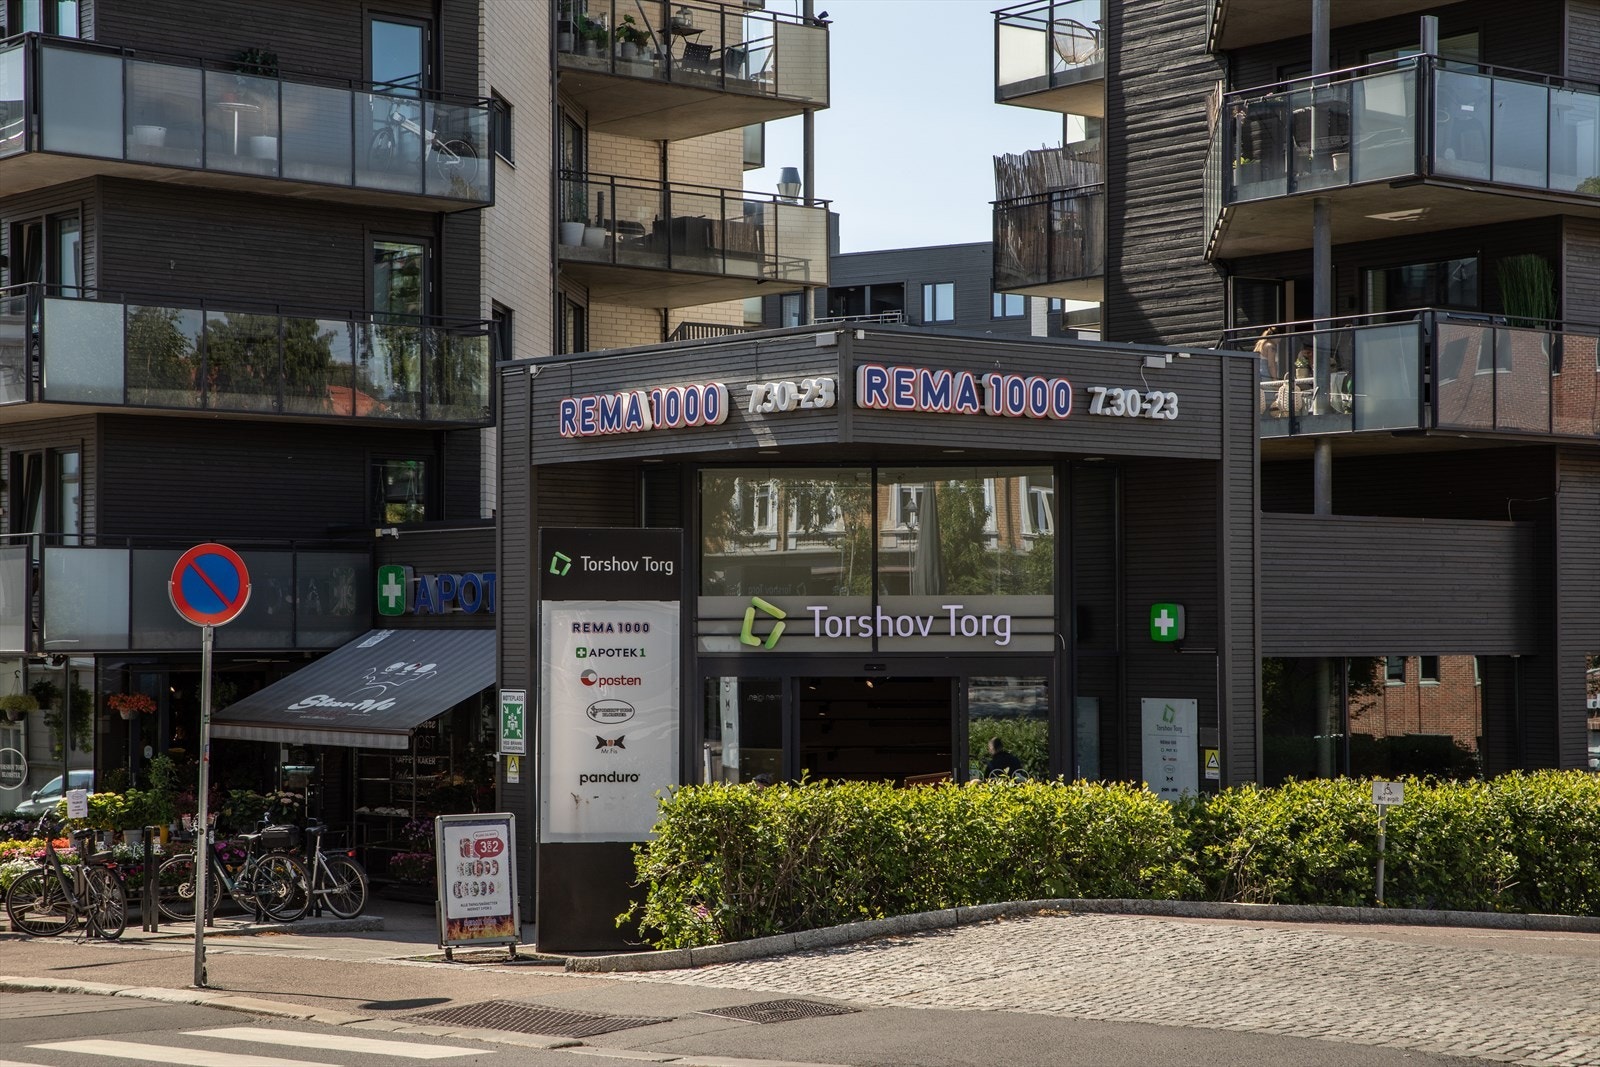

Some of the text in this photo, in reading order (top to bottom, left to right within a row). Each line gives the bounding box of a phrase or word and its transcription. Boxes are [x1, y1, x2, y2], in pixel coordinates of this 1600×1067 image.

[747, 378, 835, 413] 7.30-23
[857, 364, 1072, 419] REMA 1000
[560, 382, 728, 437] REMA 1000
[1087, 386, 1179, 420] 7.30-23
[580, 555, 674, 576] Torshov Torg
[572, 622, 650, 634] REMA 1000
[806, 604, 1011, 646] Torshov Torg
[589, 648, 647, 658] APOTEK 1
[599, 675, 642, 688] posten
[580, 771, 639, 786] panduro
[480, 841, 487, 853] 3
[492, 840, 499, 852] 2
